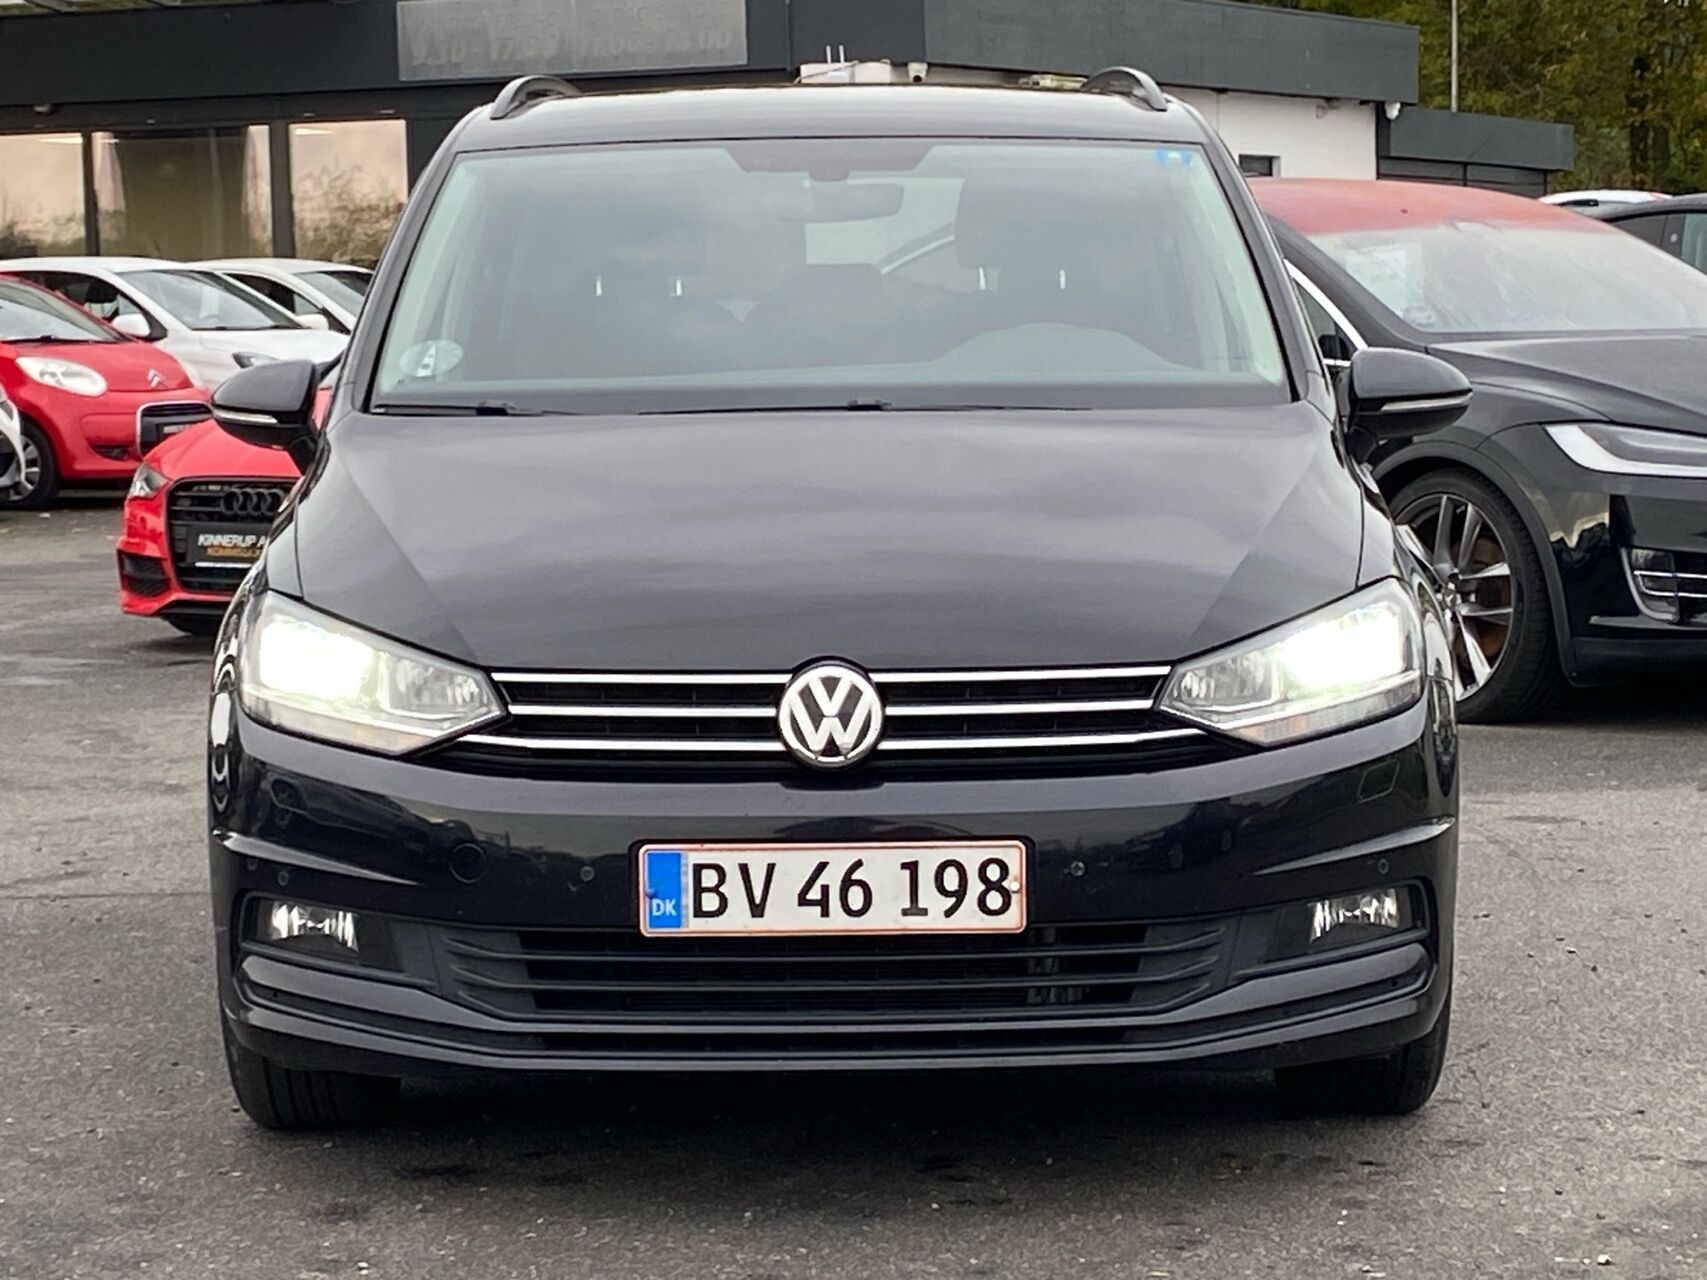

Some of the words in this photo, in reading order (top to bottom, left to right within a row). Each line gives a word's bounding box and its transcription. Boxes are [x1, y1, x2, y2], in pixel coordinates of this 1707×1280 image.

[652, 898, 678, 917] DK
[692, 862, 776, 919] BV
[797, 858, 873, 918] 46
[899, 857, 1012, 918] 198
